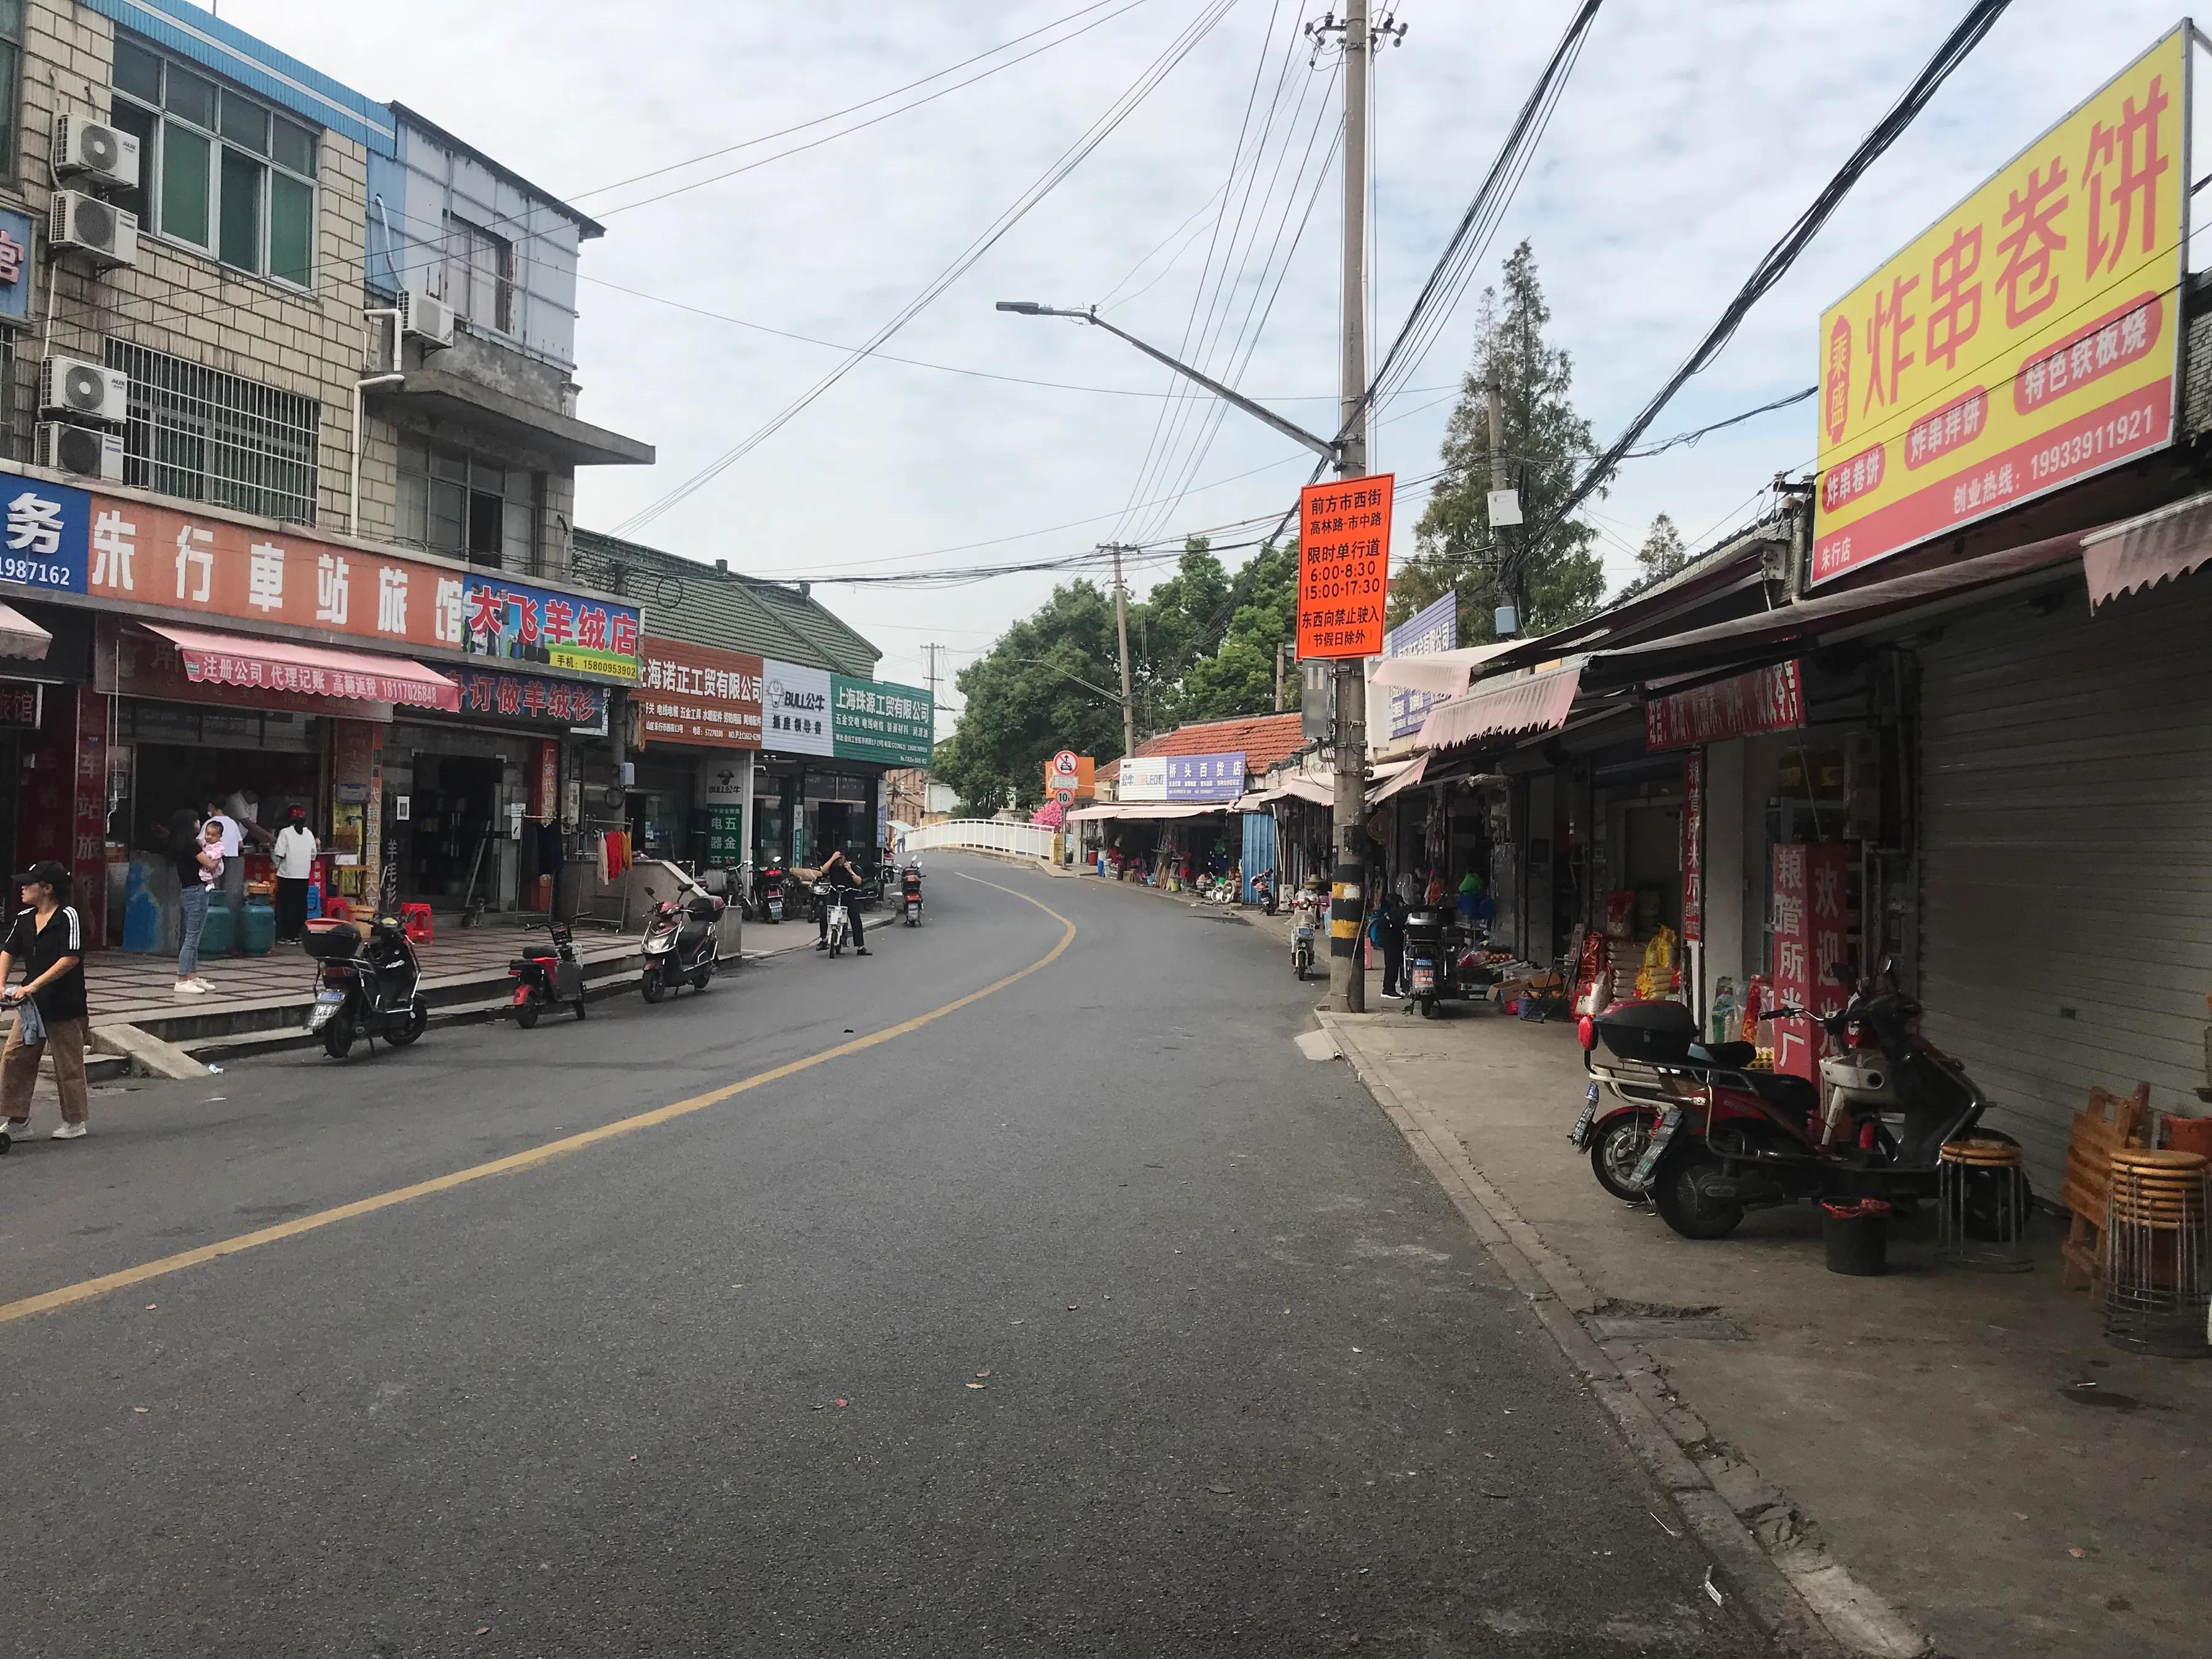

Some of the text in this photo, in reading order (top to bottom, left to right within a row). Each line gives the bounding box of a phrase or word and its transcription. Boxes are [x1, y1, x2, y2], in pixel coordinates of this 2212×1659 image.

[1864, 74, 2168, 418] 炸串卷饼
[2025, 304, 2147, 404] 特色铁板烧
[1911, 397, 1979, 462] 炸串拌饼
[2031, 405, 2153, 480] 19933911921
[1827, 450, 1879, 507] 炸串卷饼
[1311, 488, 1382, 516] 前方市西街
[6, 493, 65, 554] 务
[1308, 538, 1381, 565] 限时单行道
[1821, 537, 1851, 571] 朱行店
[1305, 578, 1380, 600] 15:00-17:30
[1311, 560, 1375, 582] 6:00-8:30
[469, 585, 637, 659] 大飞羊绒店
[1301, 605, 1379, 629] 东西向禁止驶入
[203, 656, 263, 683] 注册公司
[271, 665, 325, 691] 代理记账
[382, 680, 437, 704] 18117026848
[583, 659, 636, 677] 15800953902
[680, 707, 701, 720] 五金工具
[836, 686, 929, 724] 上海珠源工贸有限公司
[836, 713, 860, 728] 五金交电
[862, 718, 884, 732] 电线电缆
[1169, 761, 1242, 778] 桥头百货店
[386, 838, 399, 906] 羊毛衫
[1779, 850, 1805, 1067] 粮管所米厂
